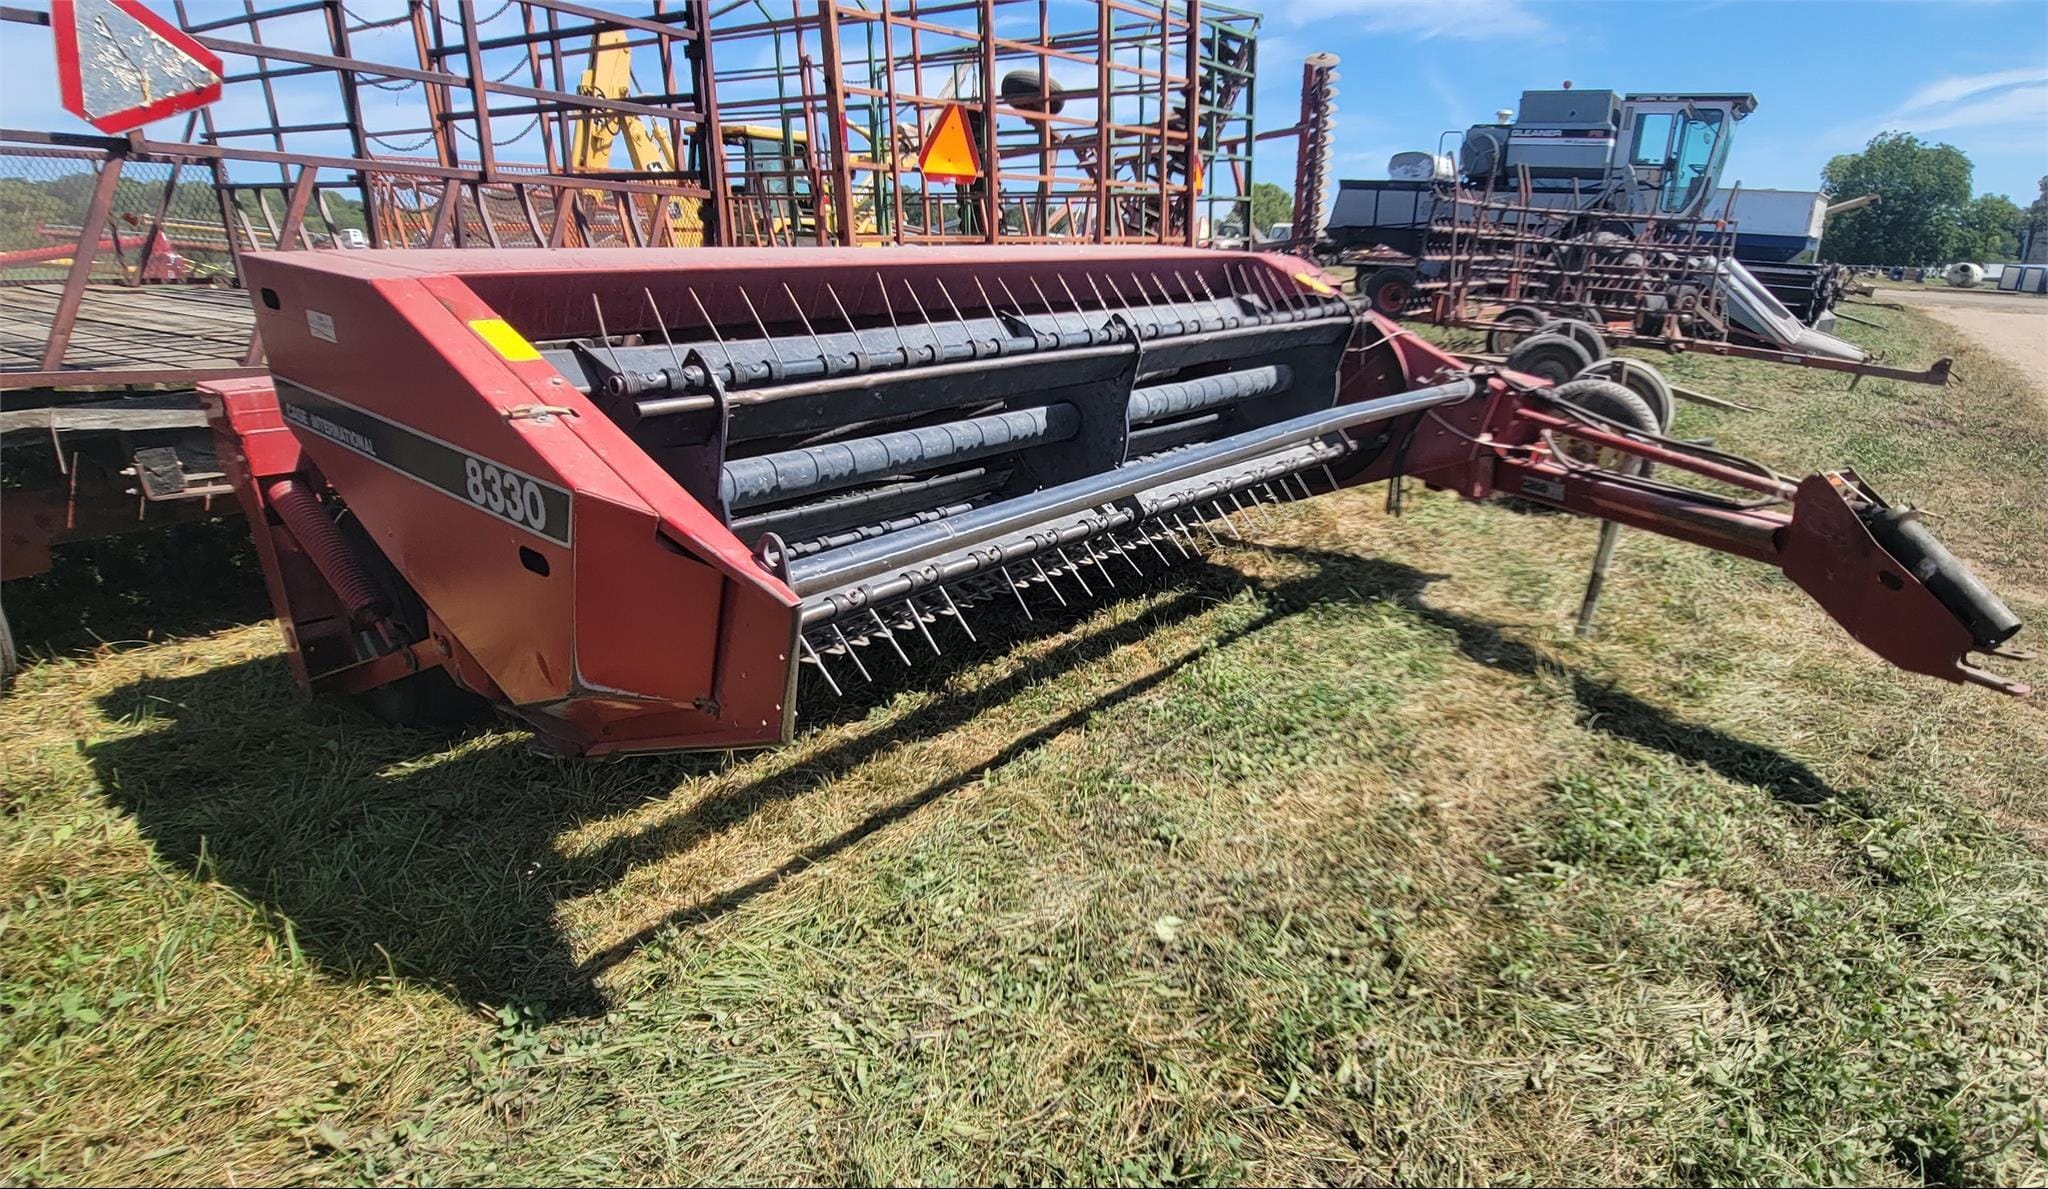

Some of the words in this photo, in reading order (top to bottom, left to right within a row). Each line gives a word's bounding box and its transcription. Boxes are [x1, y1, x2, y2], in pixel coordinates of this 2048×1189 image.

[1511, 129, 1562, 137] GLEANER
[286, 402, 310, 426] CASE
[310, 414, 377, 457] INTERNATIONAL
[465, 457, 546, 531] 8330
